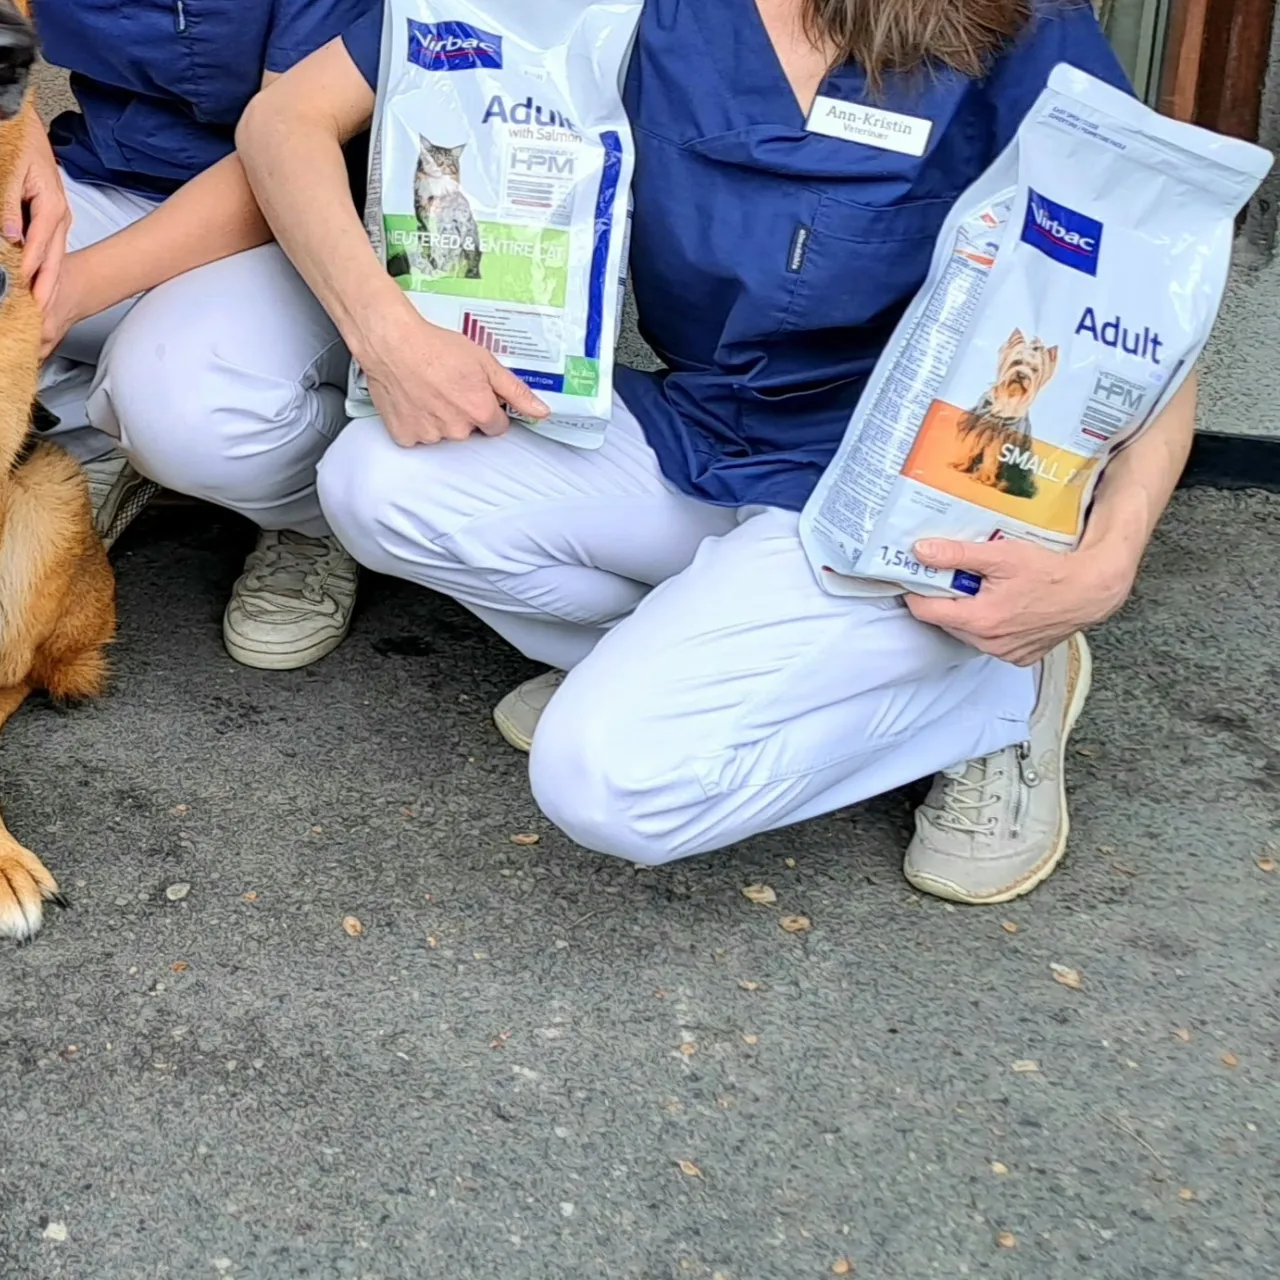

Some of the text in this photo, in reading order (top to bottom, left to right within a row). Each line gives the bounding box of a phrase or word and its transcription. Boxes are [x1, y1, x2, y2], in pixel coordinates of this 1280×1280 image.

[413, 30, 497, 54] Virbac
[508, 126, 583, 144] with Salmon
[825, 104, 913, 136] Ann-Kristin
[1031, 201, 1096, 252] Virbac
[386, 229, 567, 261] NEUTERED & ENTIRE CAT
[1074, 305, 1164, 366] Adult
[520, 375, 554, 386] TRITION
[1093, 376, 1145, 411] HPM
[997, 442, 1062, 484] SMALL
[879, 545, 921, 576] 1,5kg
